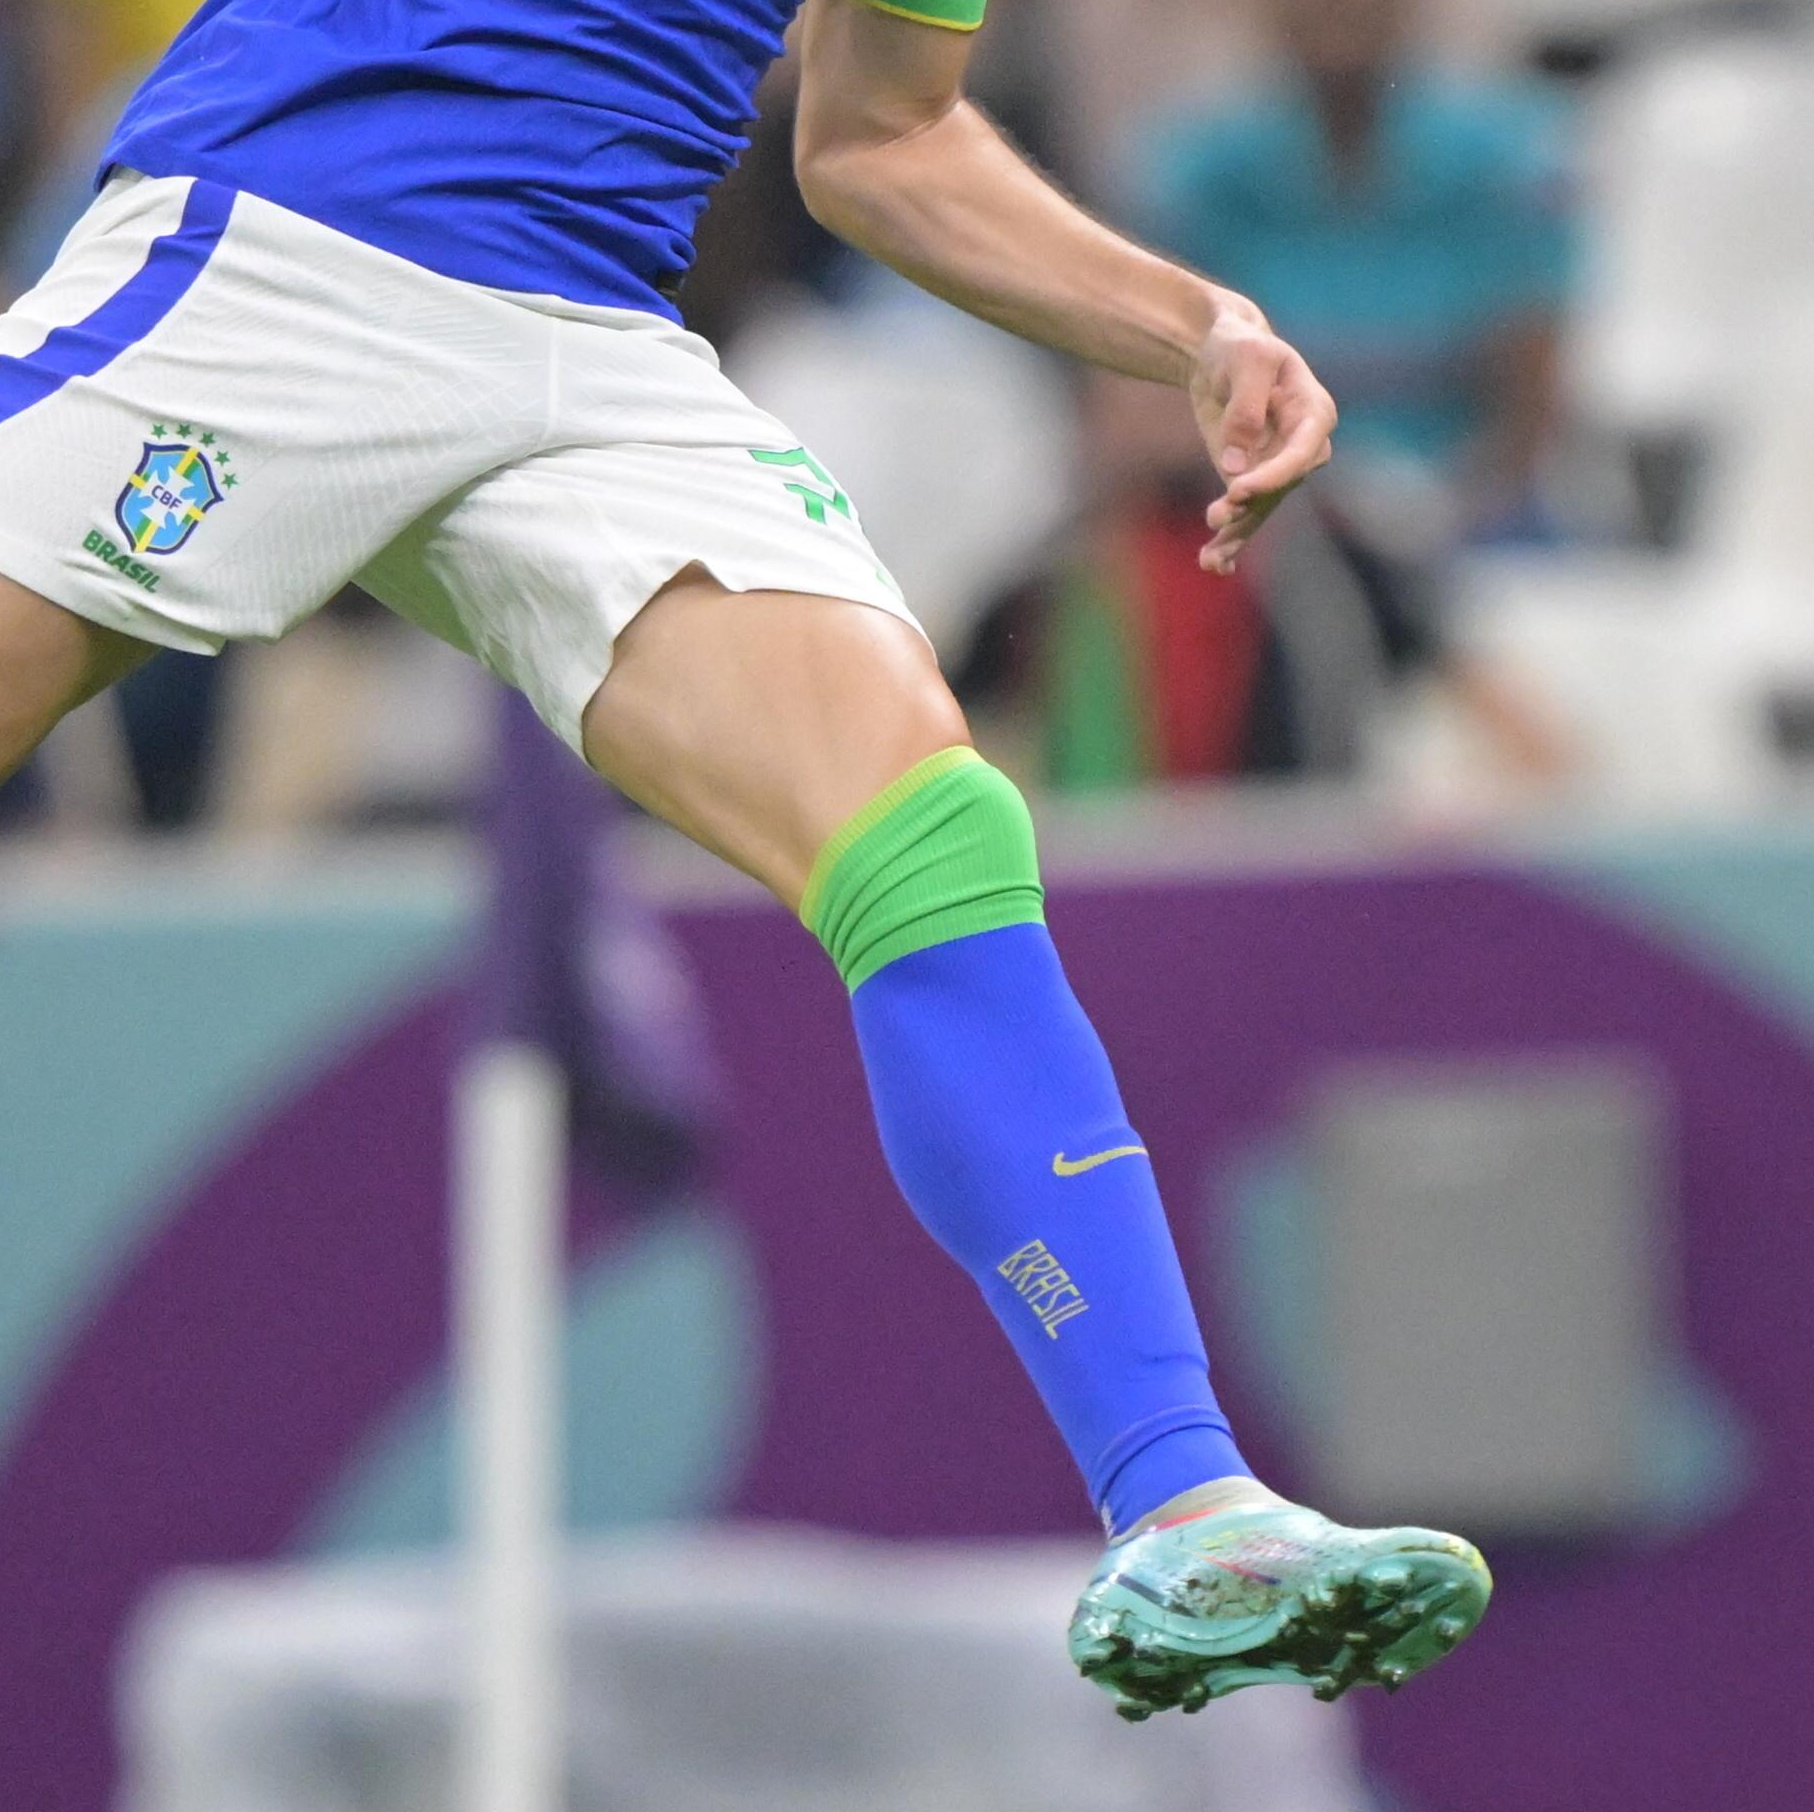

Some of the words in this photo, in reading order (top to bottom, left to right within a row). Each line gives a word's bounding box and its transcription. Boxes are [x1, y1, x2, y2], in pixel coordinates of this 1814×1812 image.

[150, 484, 183, 510] CBF
[82, 529, 161, 594] BRASIL
[997, 1239, 1089, 1340] BRASIL
